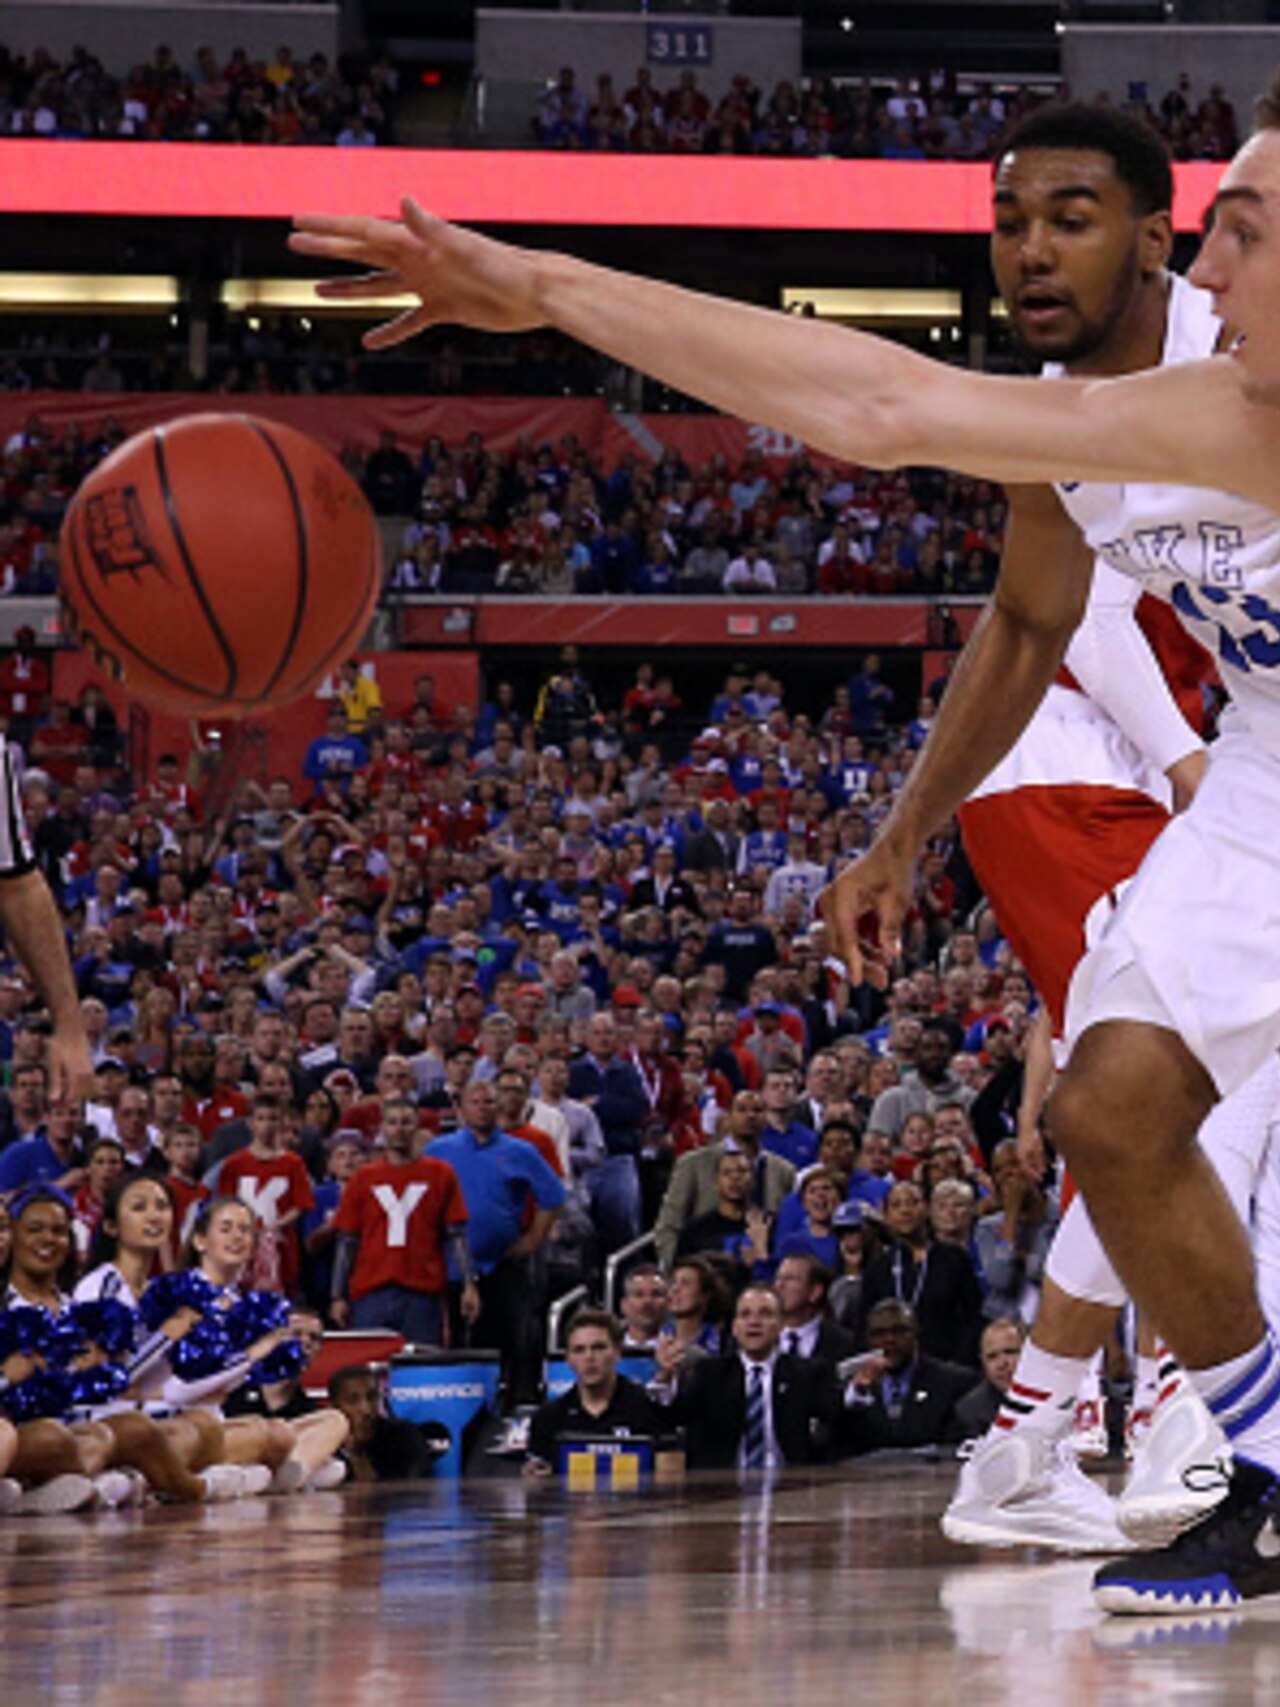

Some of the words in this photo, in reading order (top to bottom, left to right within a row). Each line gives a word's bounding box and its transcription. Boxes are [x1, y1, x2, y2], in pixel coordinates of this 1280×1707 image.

[651, 32, 708, 57] 311
[238, 1176, 290, 1231] K
[371, 1183, 428, 1247] Y
